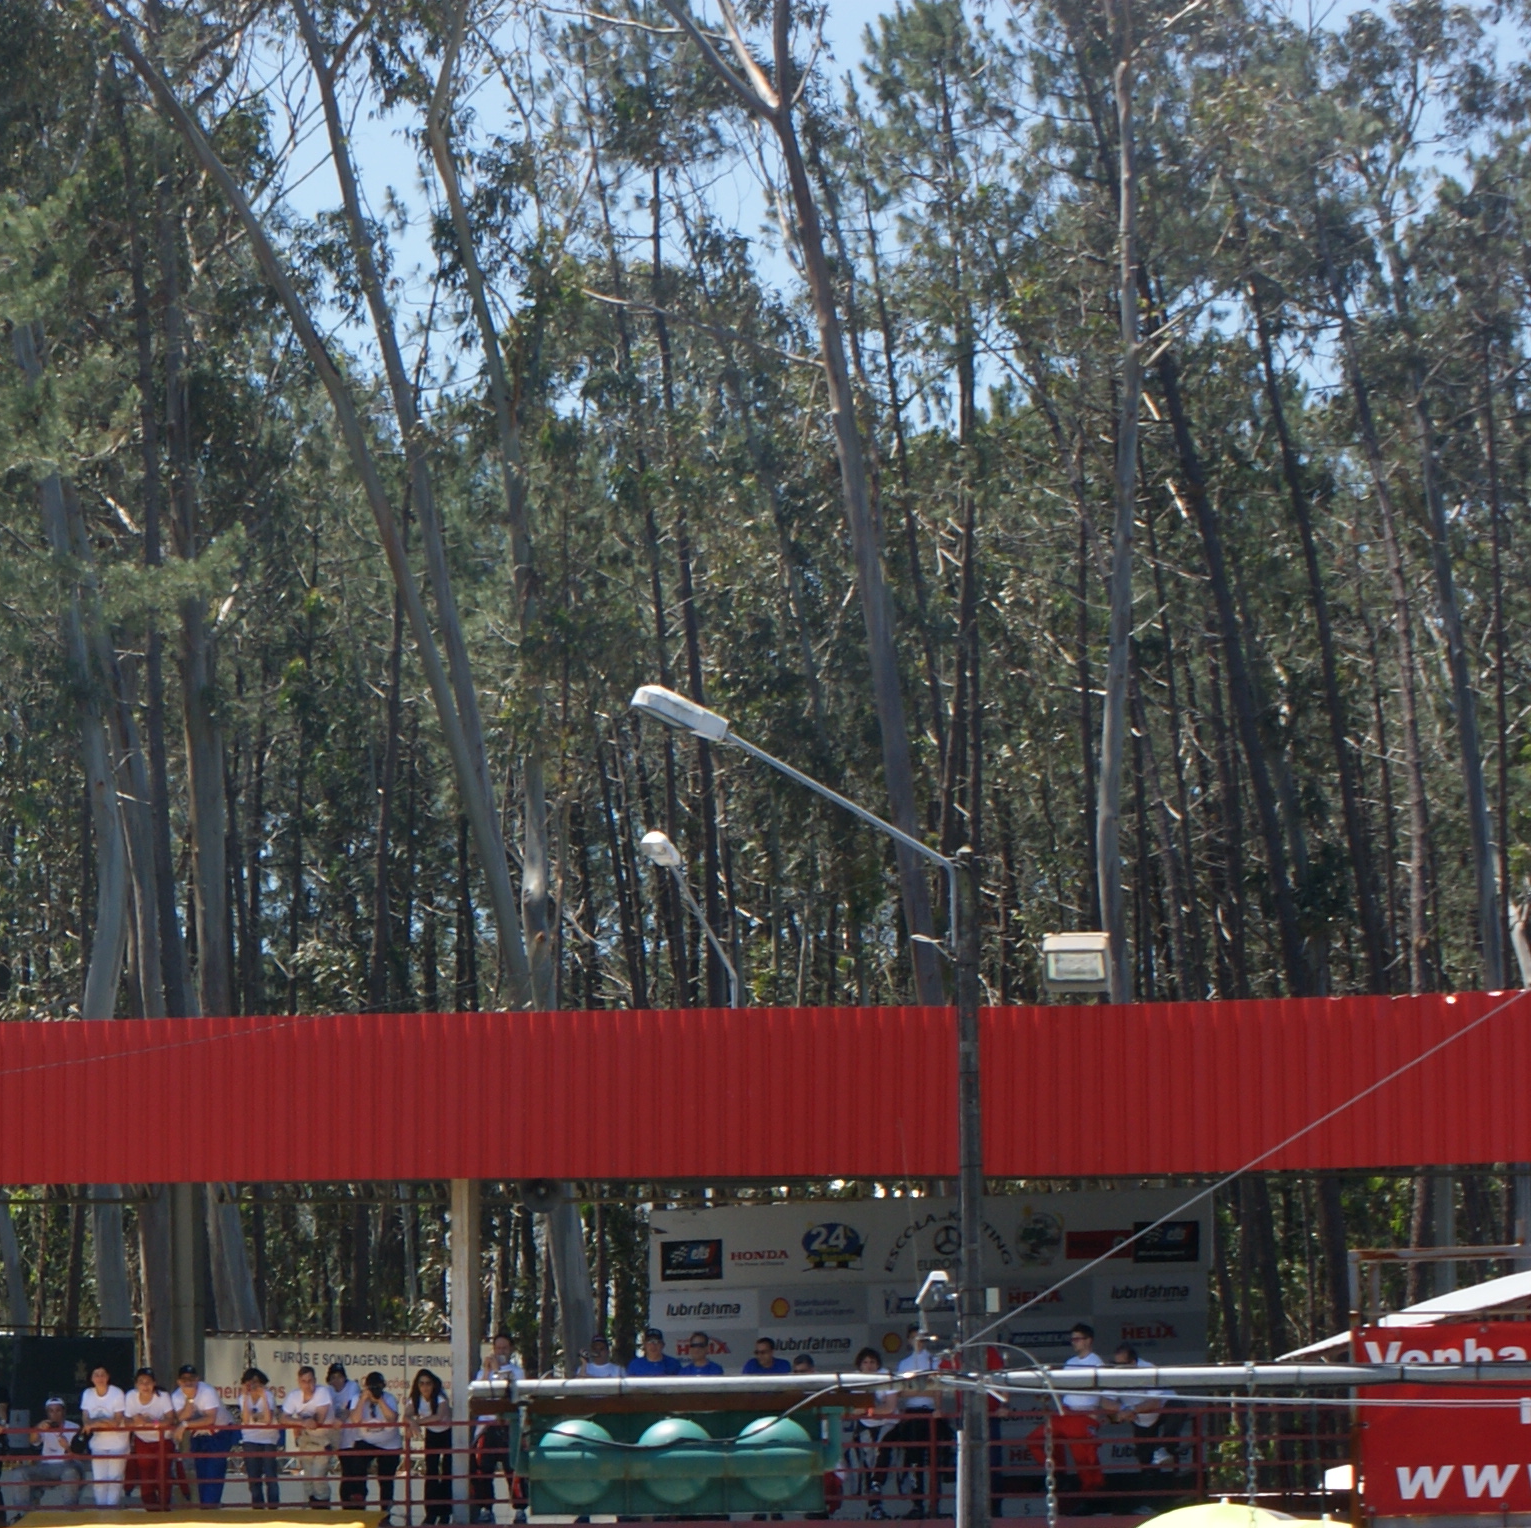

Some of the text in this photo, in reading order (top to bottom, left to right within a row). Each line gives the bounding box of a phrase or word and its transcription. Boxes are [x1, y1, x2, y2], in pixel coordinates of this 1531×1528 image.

[730, 1249, 789, 1261] HONDA
[1121, 1325, 1176, 1340] HELIX
[274, 1351, 310, 1365] FUROS
[313, 1352, 320, 1365] E
[392, 1355, 407, 1367] DE
[409, 1355, 453, 1368] MEIRINH
